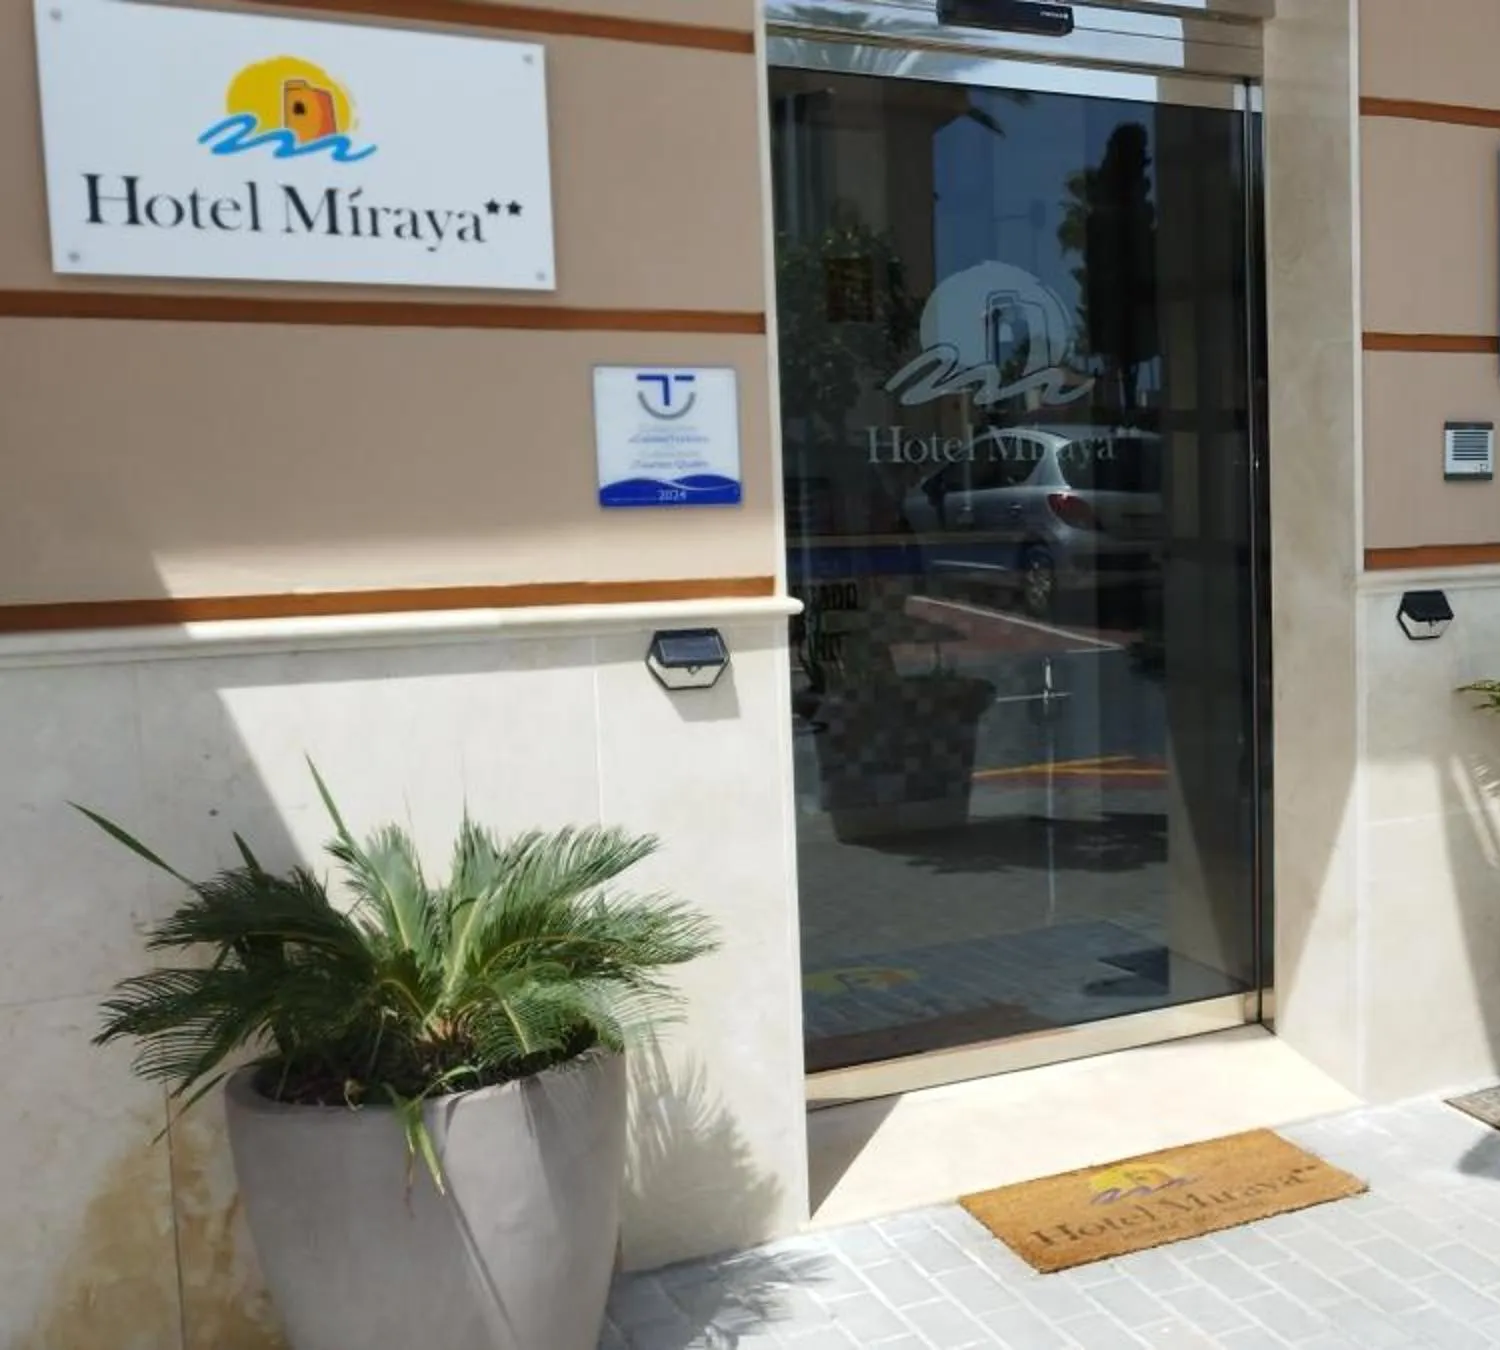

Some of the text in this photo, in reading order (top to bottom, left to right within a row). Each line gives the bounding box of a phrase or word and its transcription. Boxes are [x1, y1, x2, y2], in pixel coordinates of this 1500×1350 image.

[82, 173, 487, 252] Hotel Míraya
[864, 424, 975, 464] Hotel
[1031, 1203, 1158, 1247] Hotel
